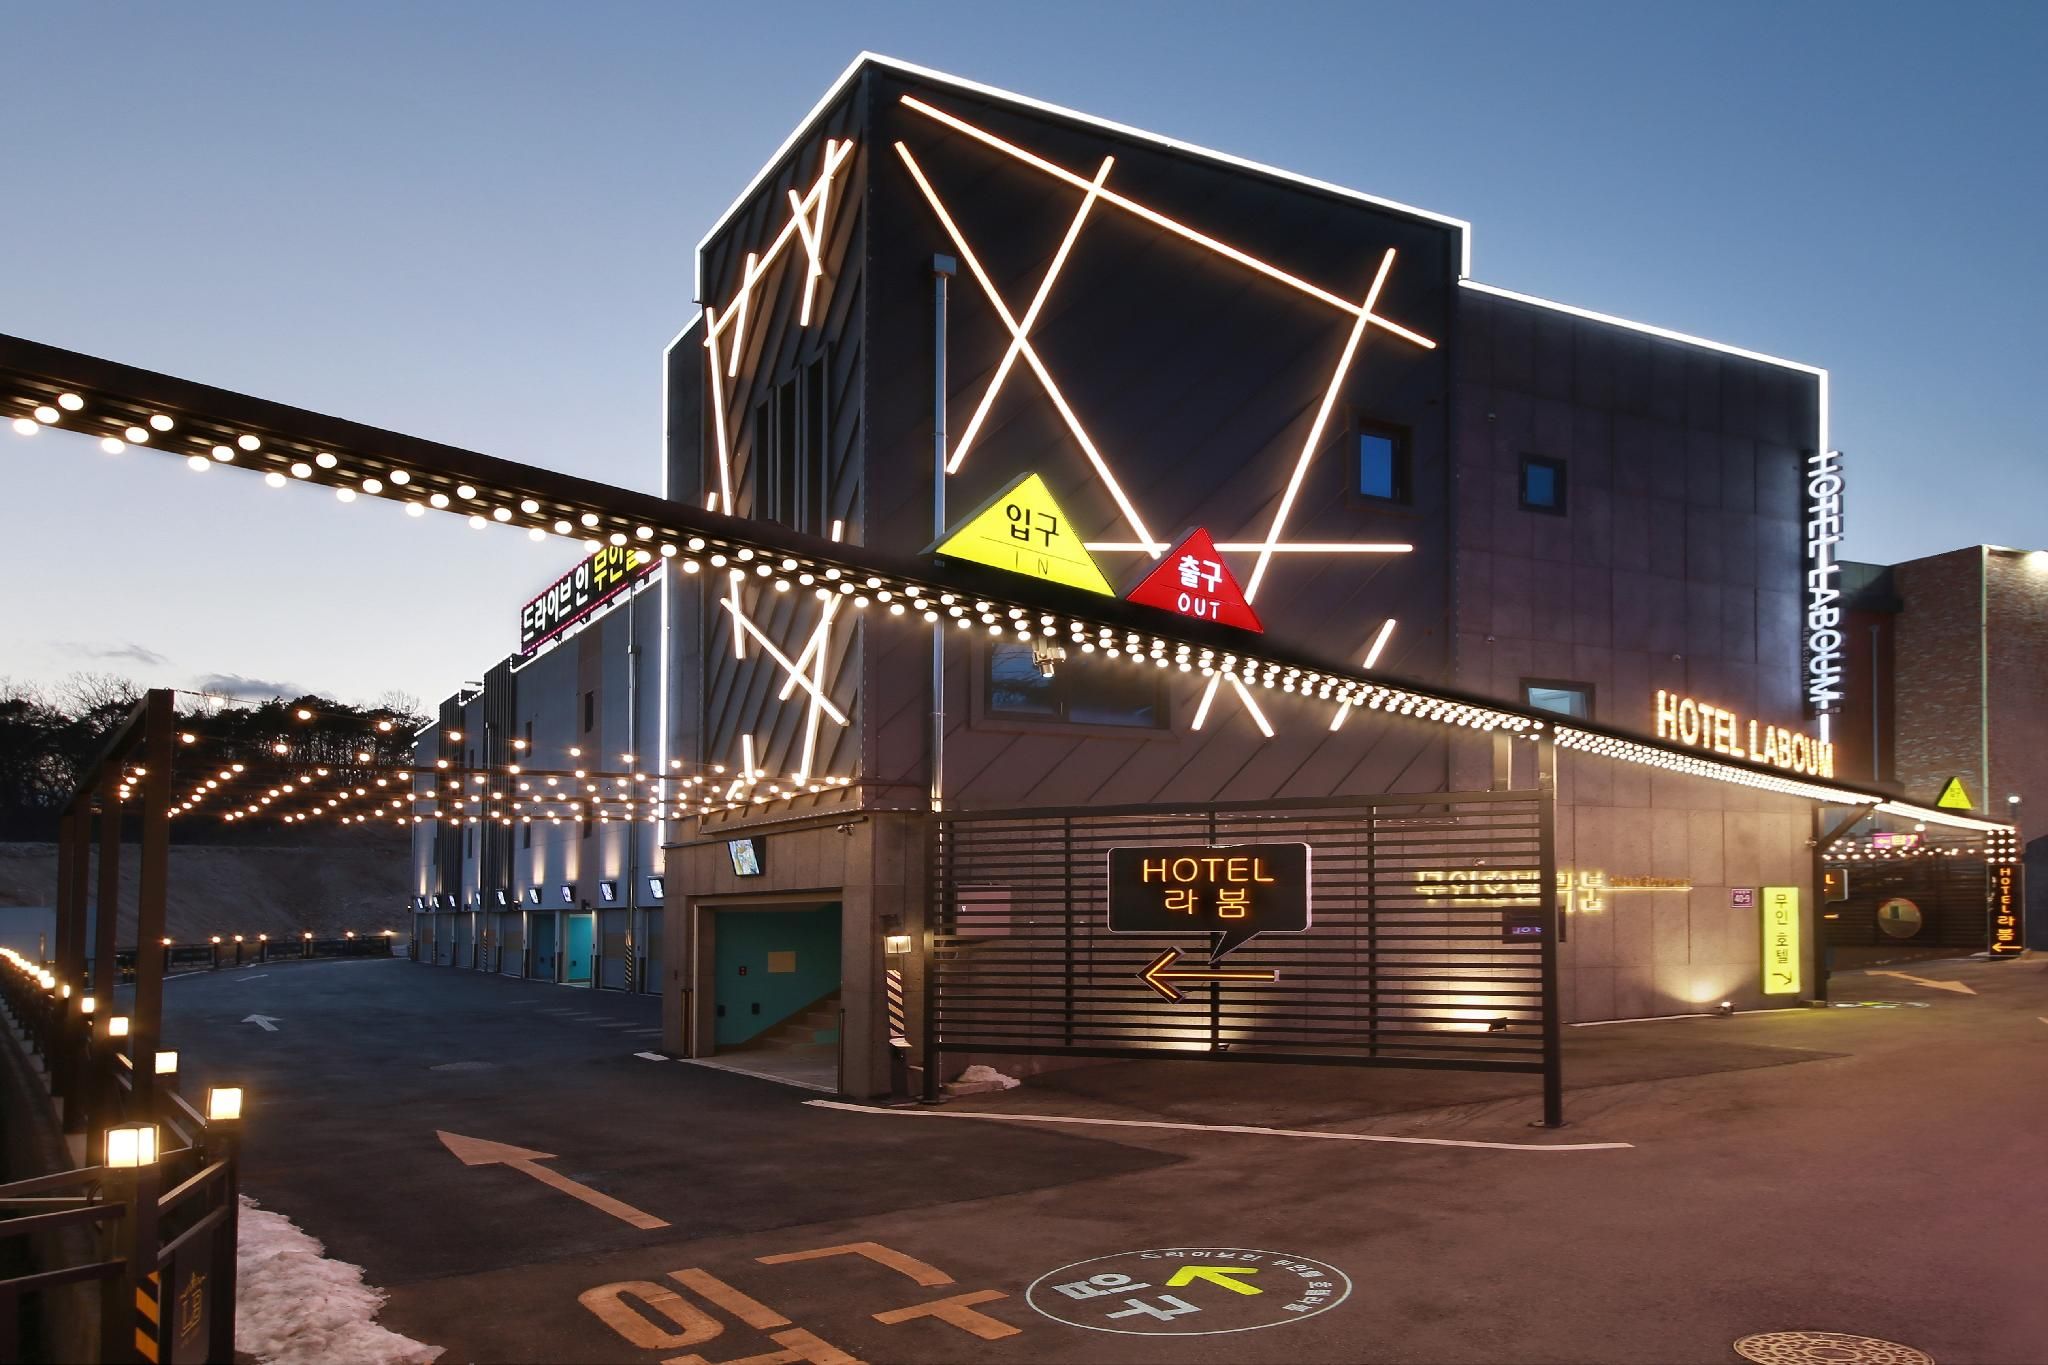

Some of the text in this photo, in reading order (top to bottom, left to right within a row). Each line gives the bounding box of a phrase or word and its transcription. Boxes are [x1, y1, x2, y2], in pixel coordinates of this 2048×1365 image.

[1005, 503, 1060, 547] 입구
[1178, 555, 1223, 593] 출구
[1808, 450, 1842, 703] HOTEL LABOUM
[1177, 592, 1221, 619] OUT
[1656, 689, 1834, 779] HOTEL LABOUM
[1143, 857, 1275, 883] HOTEL
[1999, 867, 2011, 914] HOTEL
[1052, 1273, 1203, 1321] 입구
